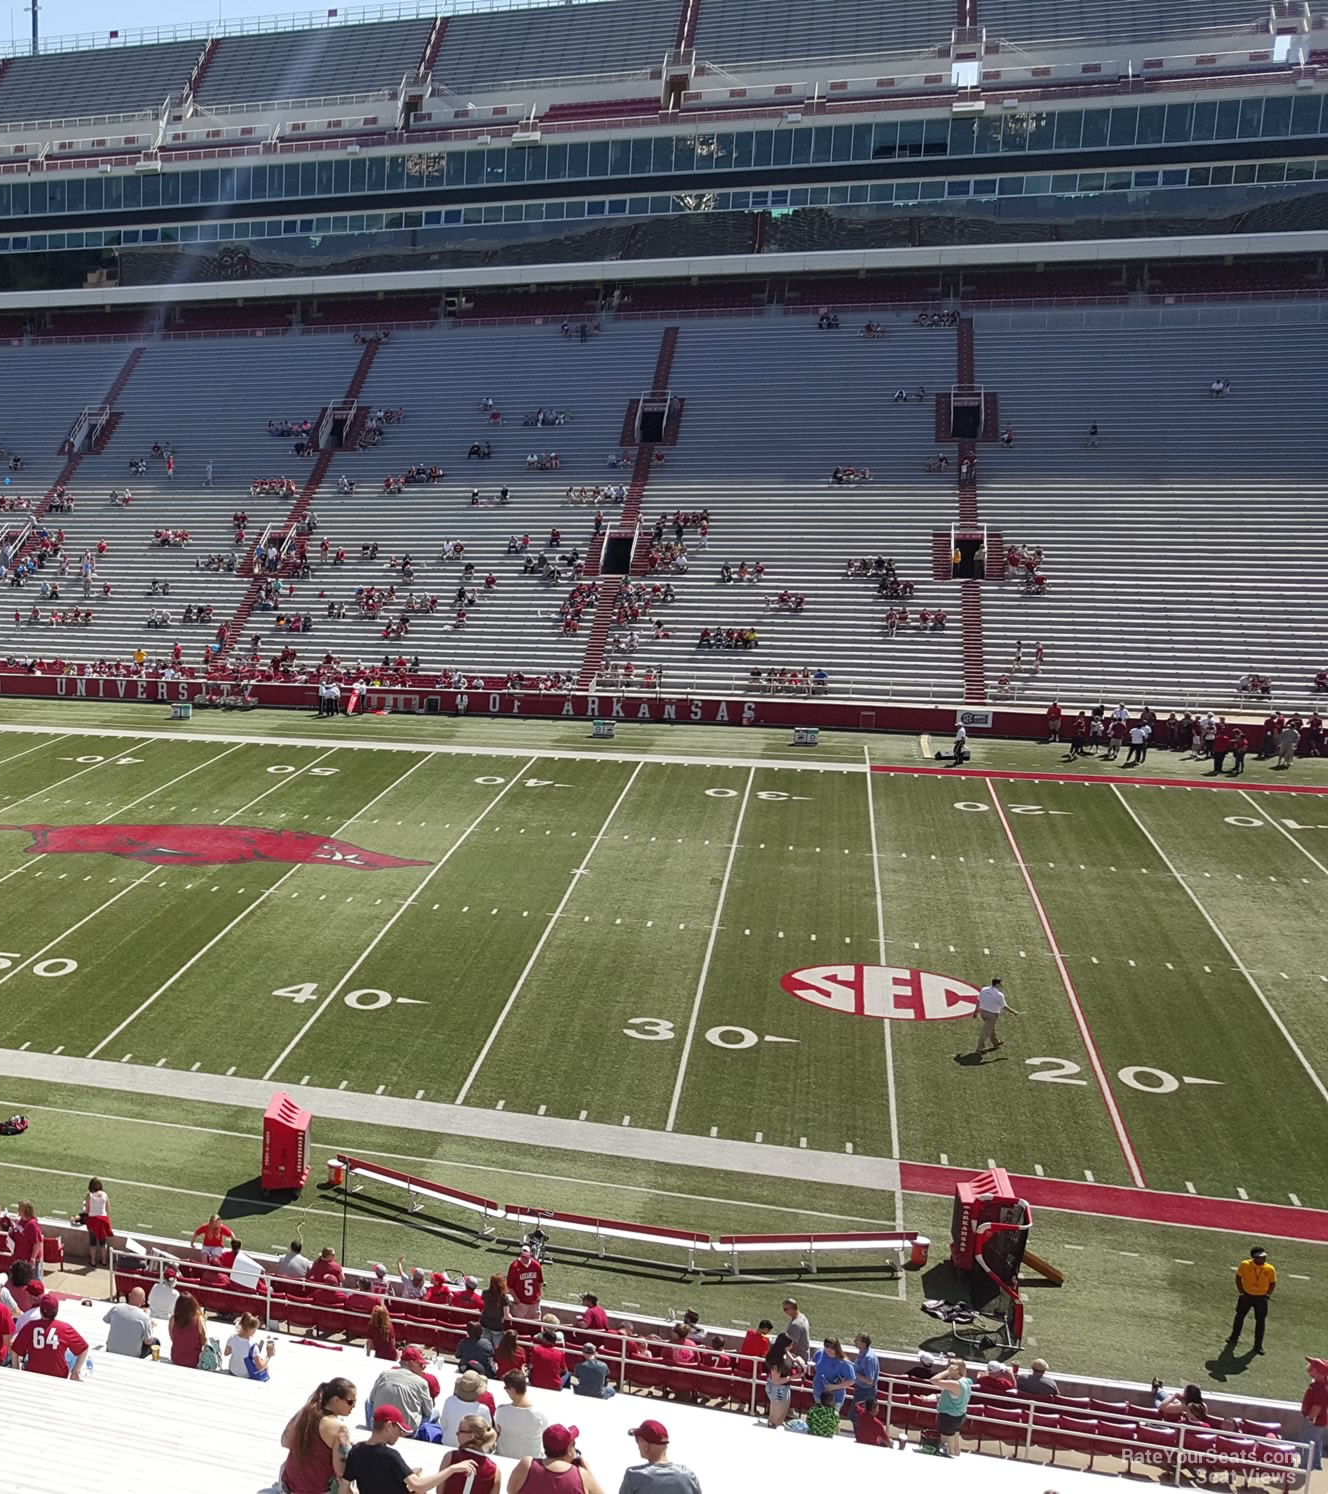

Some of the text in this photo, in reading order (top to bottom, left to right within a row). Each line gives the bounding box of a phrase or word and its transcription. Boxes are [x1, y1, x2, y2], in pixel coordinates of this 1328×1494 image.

[561, 694, 756, 722] ARKANSAS
[791, 964, 981, 1020] SEC
[524, 1280, 534, 1297] 5
[32, 1326, 60, 1350] 64
[711, 1355, 720, 1369] 7
